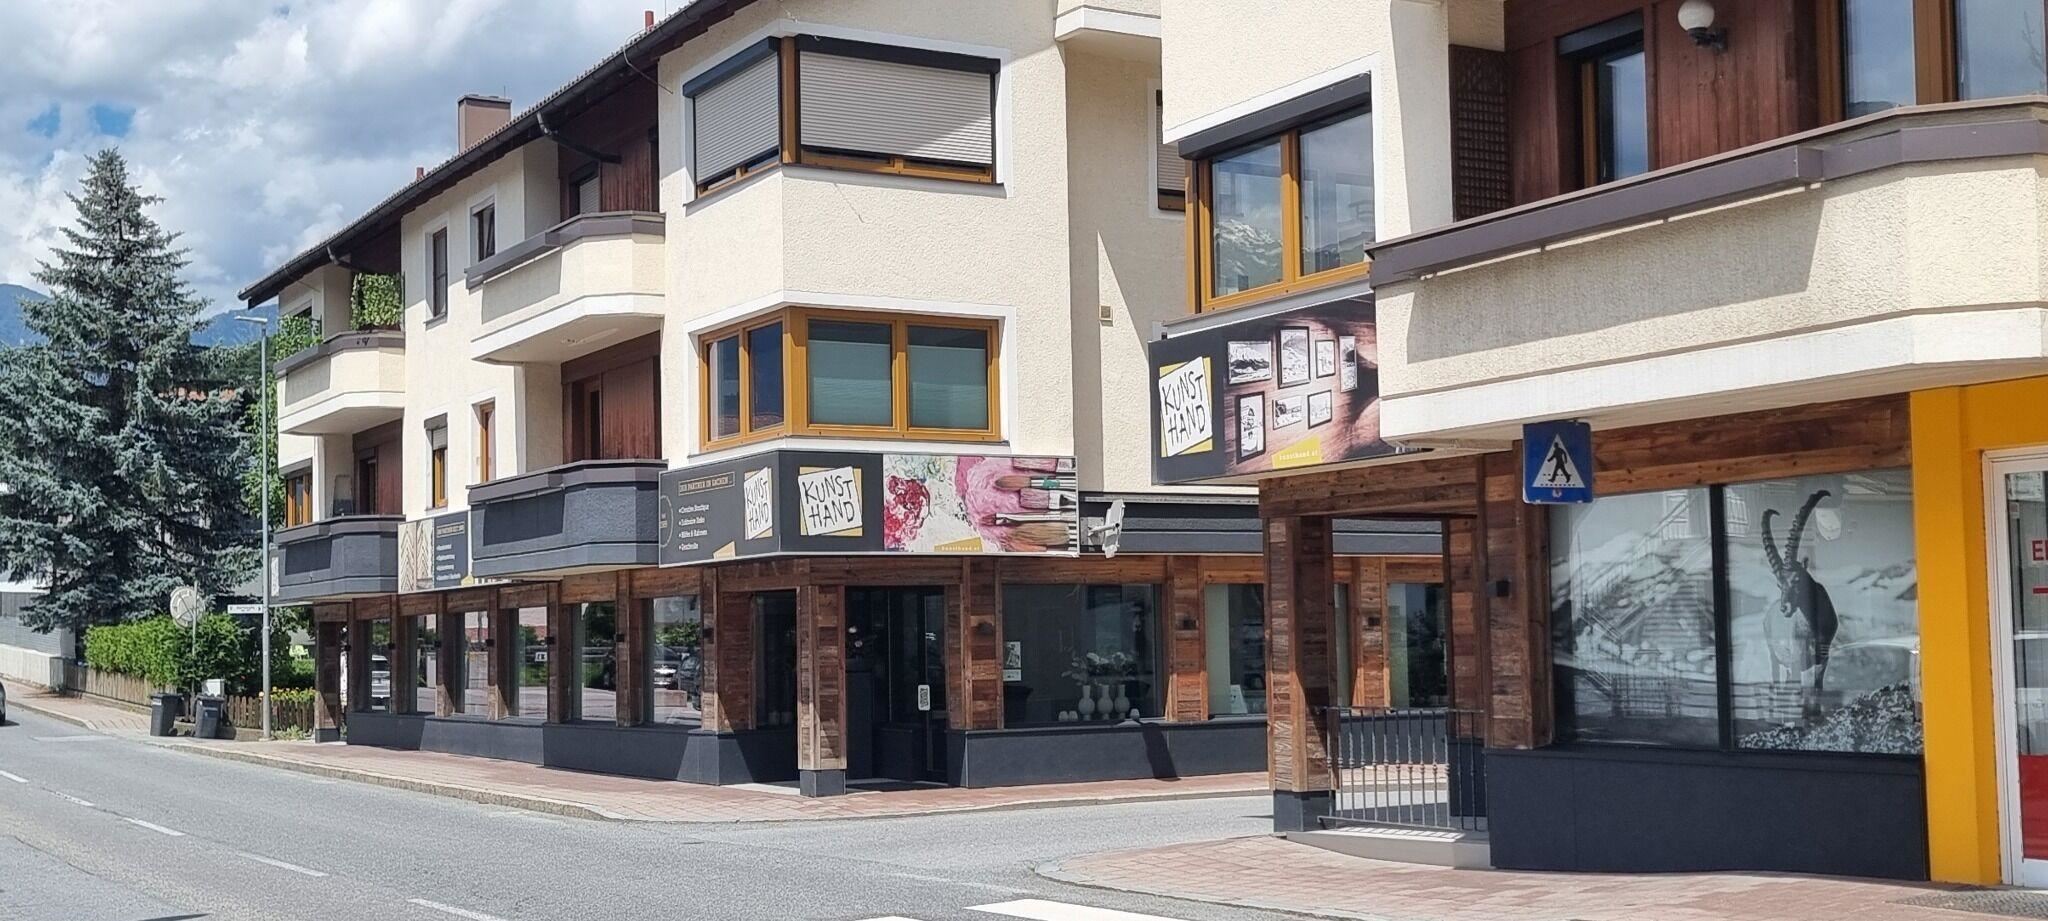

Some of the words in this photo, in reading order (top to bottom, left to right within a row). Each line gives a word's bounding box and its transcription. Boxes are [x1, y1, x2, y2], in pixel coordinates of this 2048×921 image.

[1162, 370, 1204, 415] KUNST
[1168, 404, 1206, 445] HAND
[745, 477, 768, 504] KUNST
[803, 475, 853, 503] KUNST
[748, 502, 769, 532] HAND
[809, 501, 855, 529] HAND
